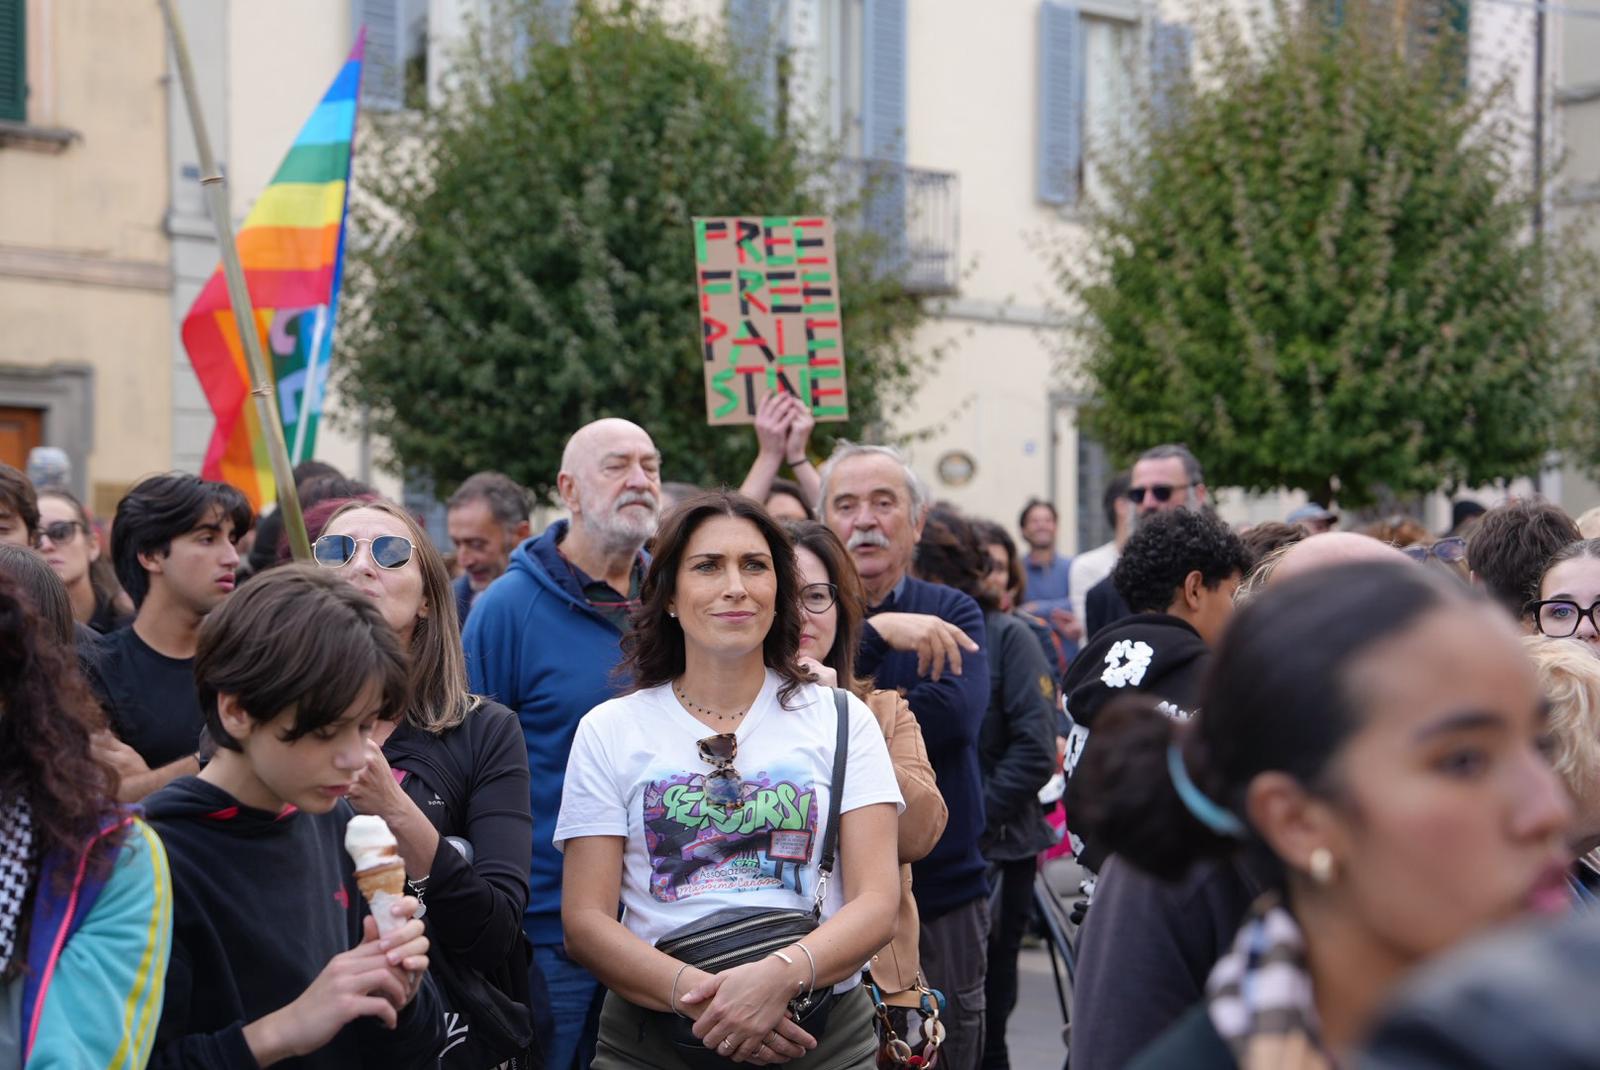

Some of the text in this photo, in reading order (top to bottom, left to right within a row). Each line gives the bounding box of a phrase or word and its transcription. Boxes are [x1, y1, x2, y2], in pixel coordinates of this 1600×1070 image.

[695, 217, 828, 266] FREE
[701, 269, 836, 315] FREE
[703, 316, 840, 366] PALE
